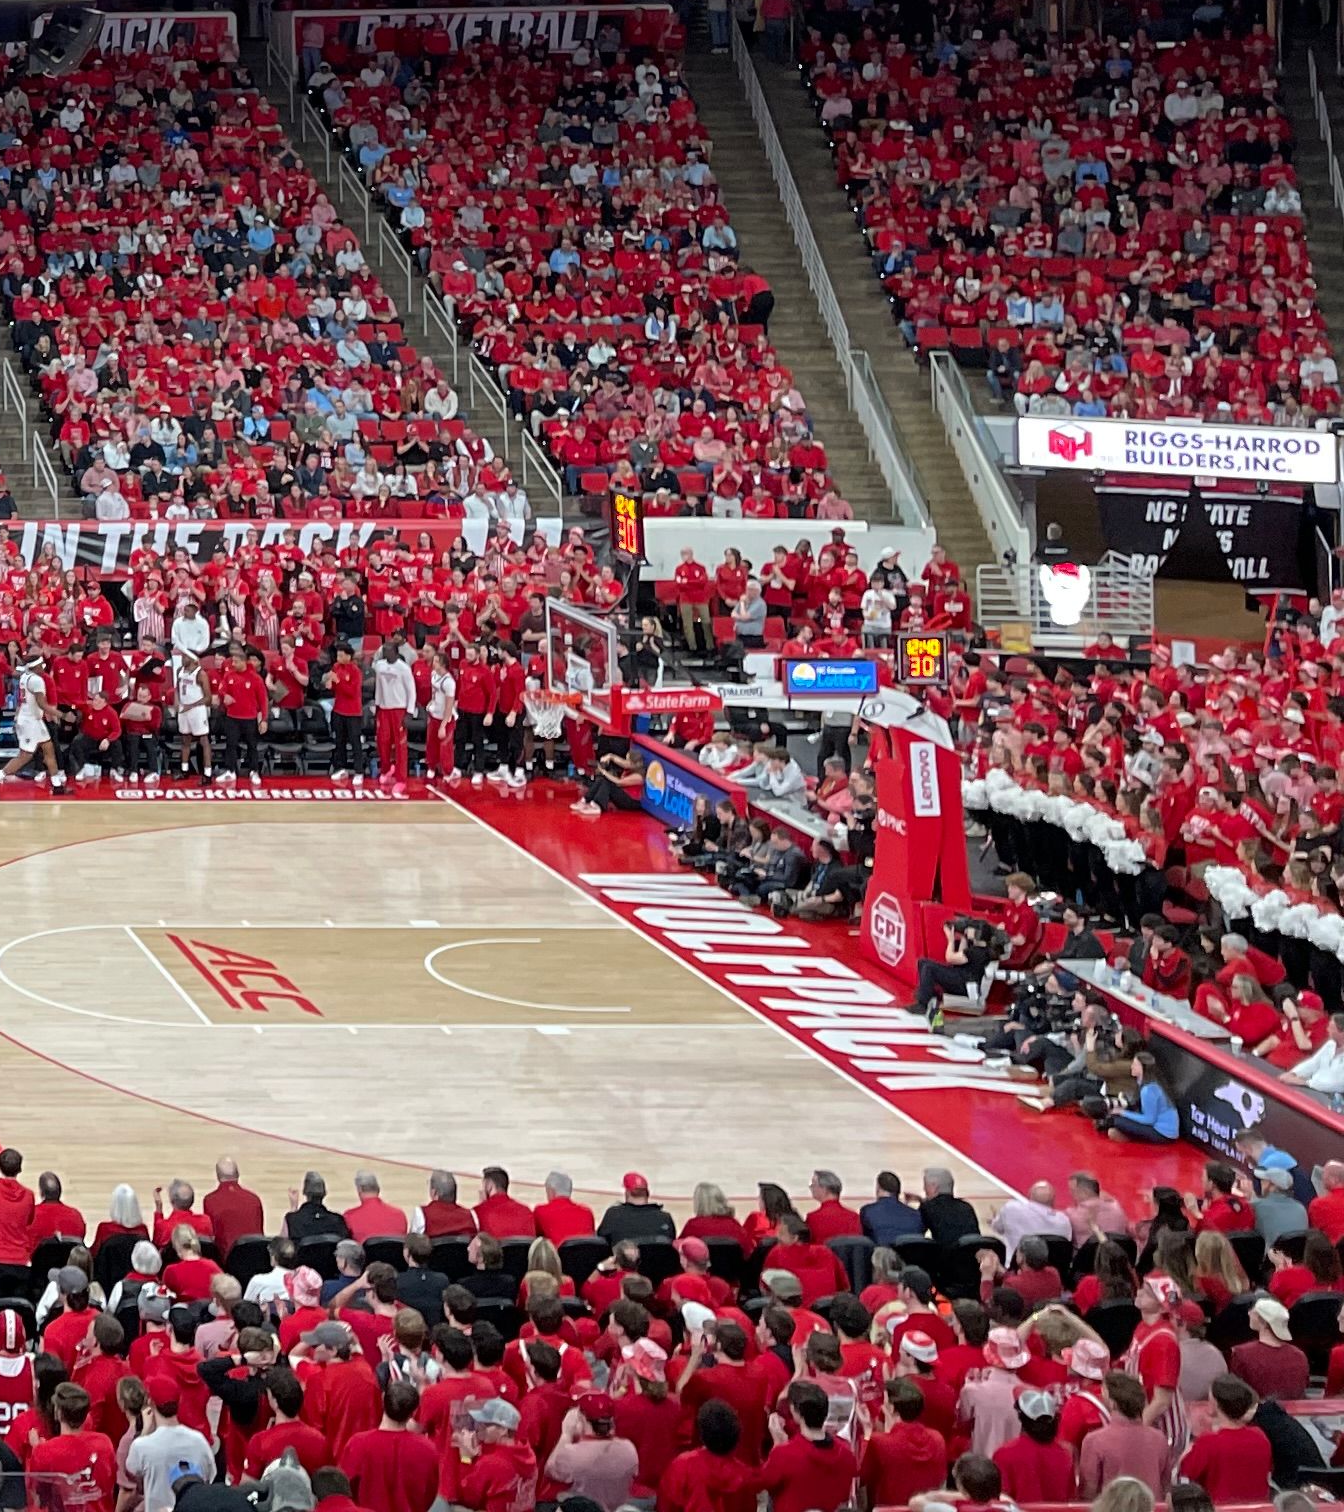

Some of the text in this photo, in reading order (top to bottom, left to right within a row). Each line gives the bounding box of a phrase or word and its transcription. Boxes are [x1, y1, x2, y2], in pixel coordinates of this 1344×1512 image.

[99, 18, 175, 56] ACK
[1125, 429, 1320, 455] RIGGS-HARROD
[1146, 501, 1176, 523] NC
[910, 656, 935, 677] 30
[817, 674, 870, 691] Lottery
[919, 749, 933, 810] Lenovo
[874, 914, 903, 945] CPI
[191, 939, 323, 1017] ACC
[578, 871, 1045, 1097] WOLFPACK
[1191, 1126, 1209, 1144] AND
[1206, 1115, 1231, 1139] Heel
